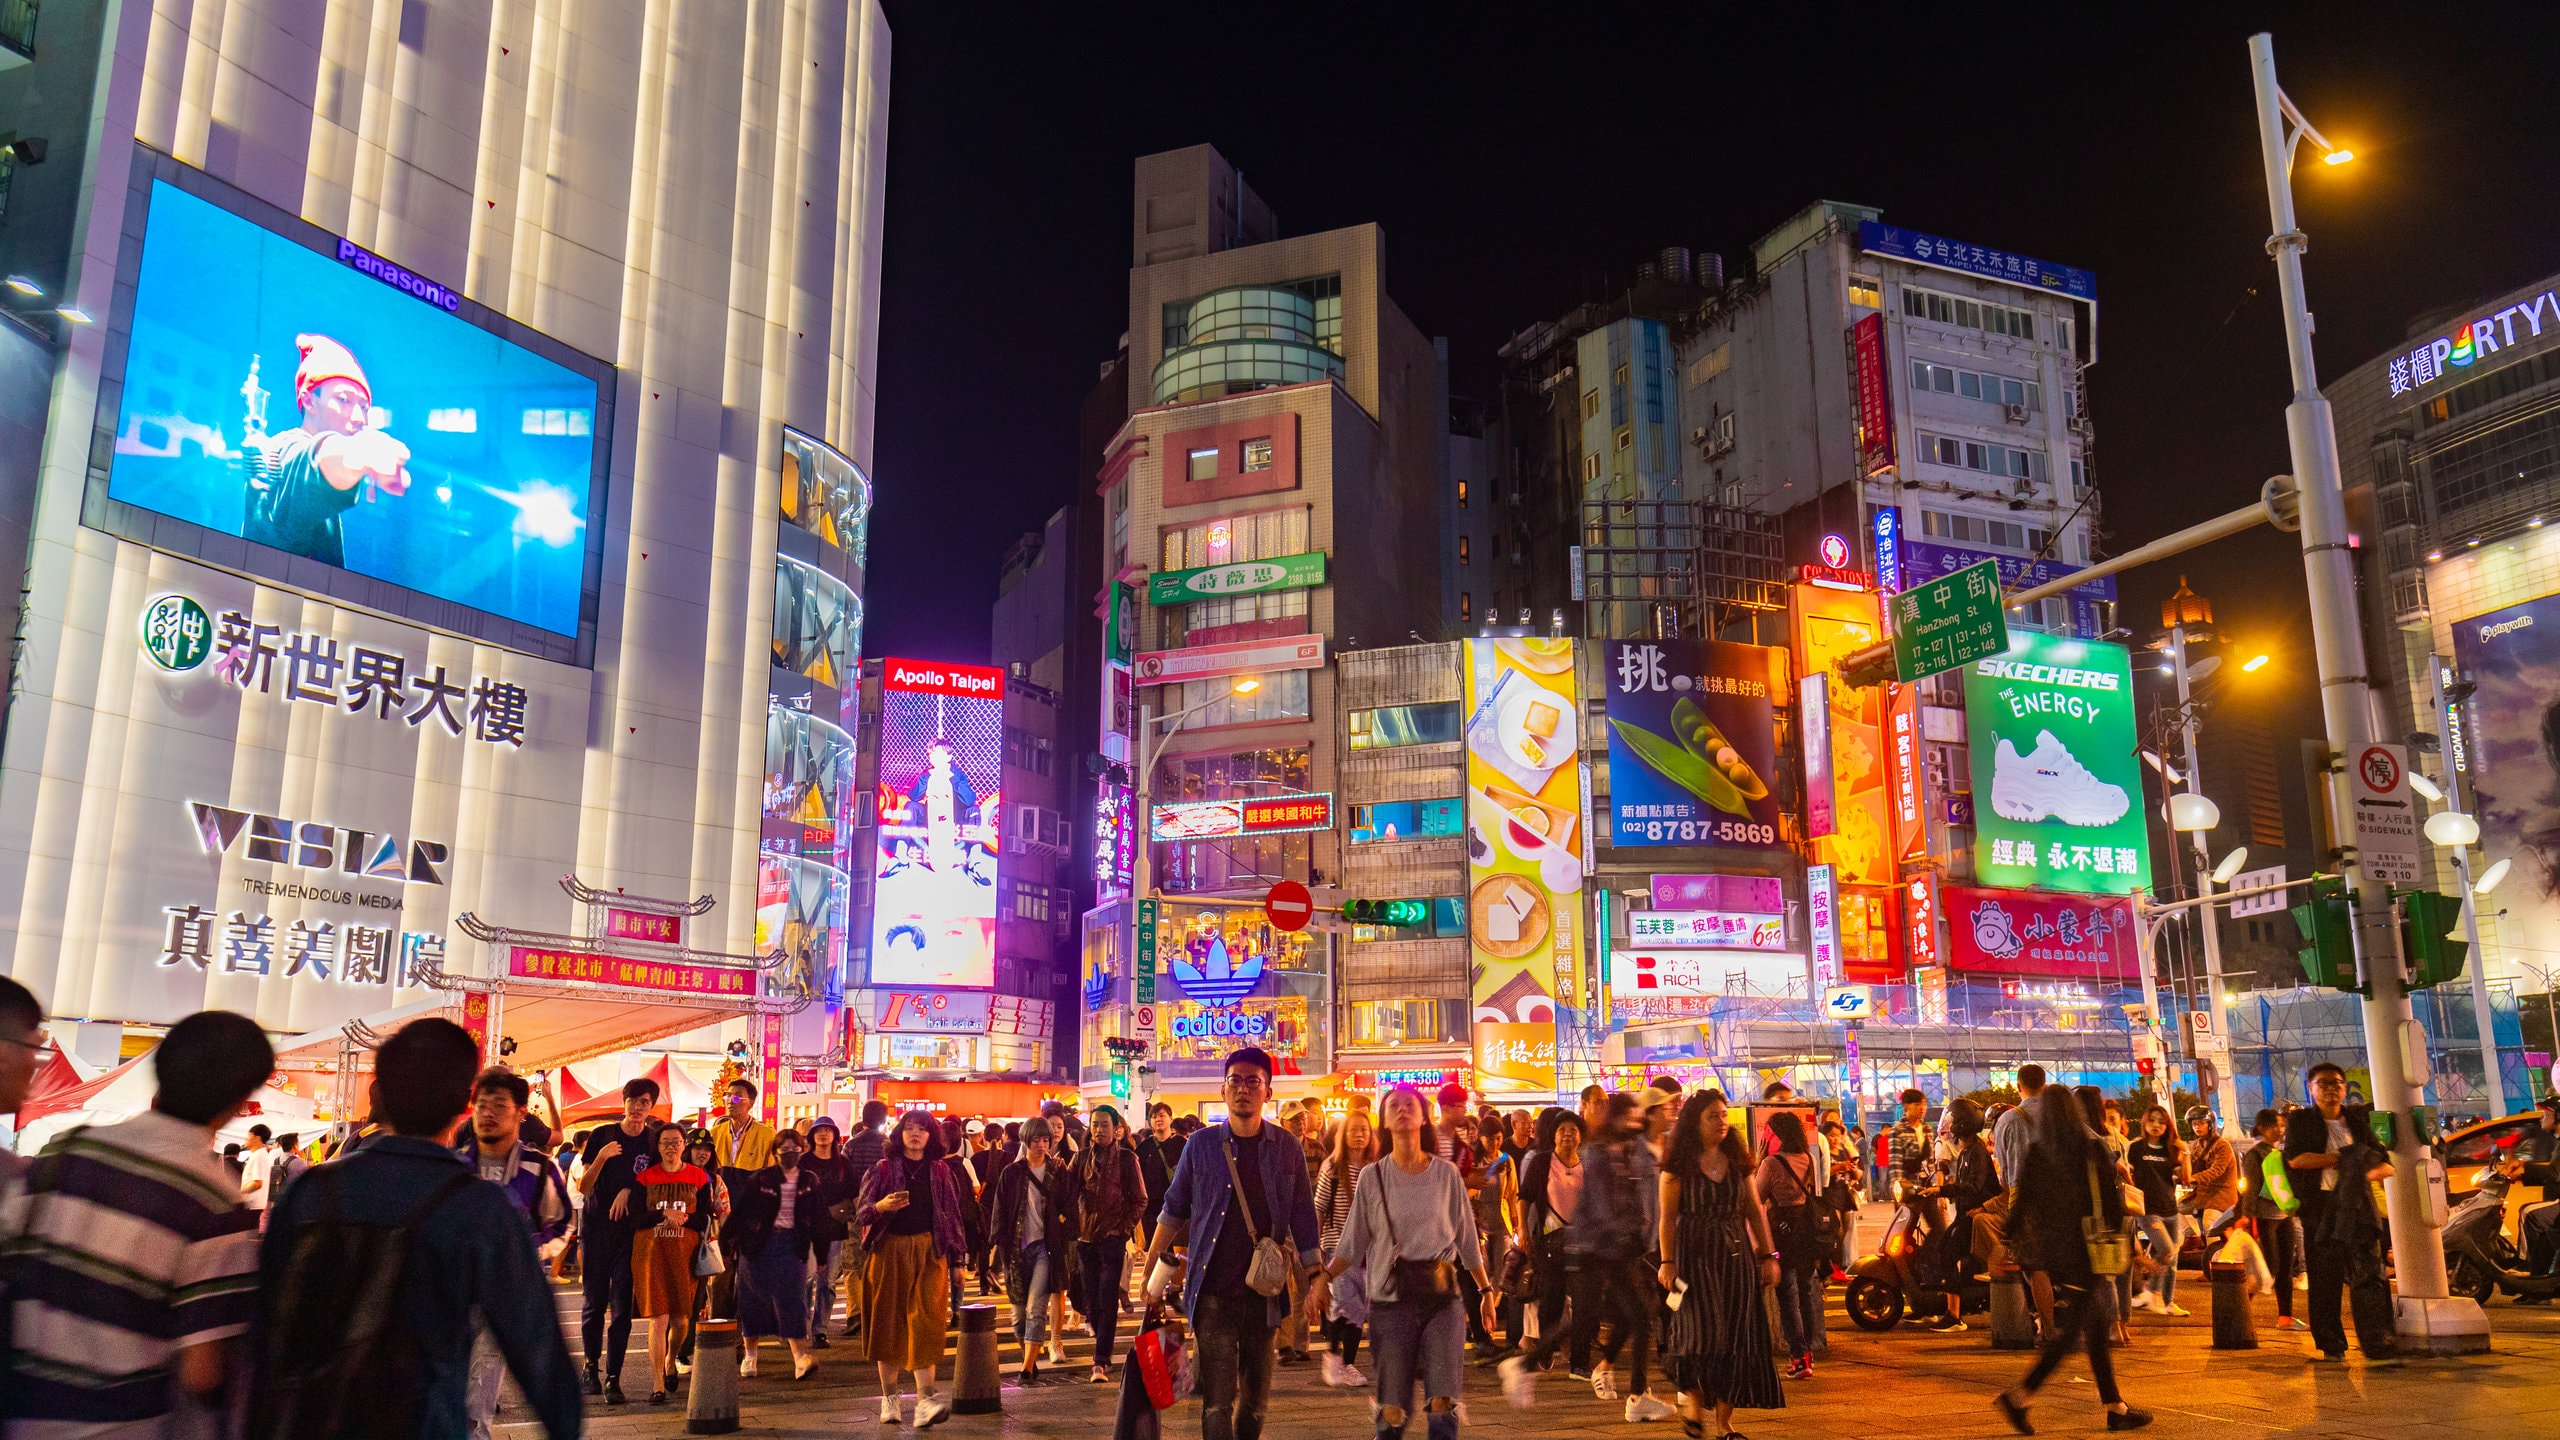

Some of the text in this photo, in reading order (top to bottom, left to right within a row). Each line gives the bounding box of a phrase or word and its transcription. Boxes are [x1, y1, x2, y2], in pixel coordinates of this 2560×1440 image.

[1936, 240, 2038, 277] 台北天禾旅店
[1943, 258, 1972, 270] TAIPEI
[2004, 271, 2033, 283] HOTEL
[338, 239, 458, 312] Panasonic
[2388, 344, 2434, 398] 錢櫃
[1198, 567, 1274, 591] 詩薇思
[1834, 568, 1873, 590] STONE
[1161, 589, 1181, 599] SPA
[1900, 568, 1987, 624] 漢中街
[1916, 605, 1980, 636] HanZhong St
[2491, 615, 2533, 638] playwith
[1301, 648, 1314, 656] 6F
[213, 610, 529, 749] 新世界大樓
[893, 667, 996, 692] Apollo Taipei
[1616, 643, 1669, 693] 挑
[1976, 658, 2119, 690] SKECHERS
[1695, 675, 1766, 698] 就挑最好的
[1998, 687, 2101, 724] THE ENERGY
[2036, 768, 2060, 777] SKX
[2367, 758, 2392, 784] 停
[1245, 804, 1327, 825] 嚴選美國和牛
[1622, 820, 1775, 845] (02) 8787-5869
[2368, 825, 2414, 836] SIDEWALK
[1991, 837, 2138, 875] 經典 永不退潮
[2366, 860, 2416, 870] TOW-AWAY ZONE
[2393, 870, 2412, 880] 110
[242, 877, 404, 911] TREMENDOUS MEDIA
[1813, 891, 1830, 929] 按摩
[1141, 912, 1153, 962] 漢中街
[1635, 918, 1675, 935] 玉芙蓉
[1692, 915, 1721, 934] 按摩
[1723, 916, 1747, 934] 護膚
[157, 903, 447, 988] 真善美劇院
[1555, 909, 1574, 996] 首選維格
[1663, 974, 1700, 986] RICH
[1172, 1011, 1266, 1036] adidas
